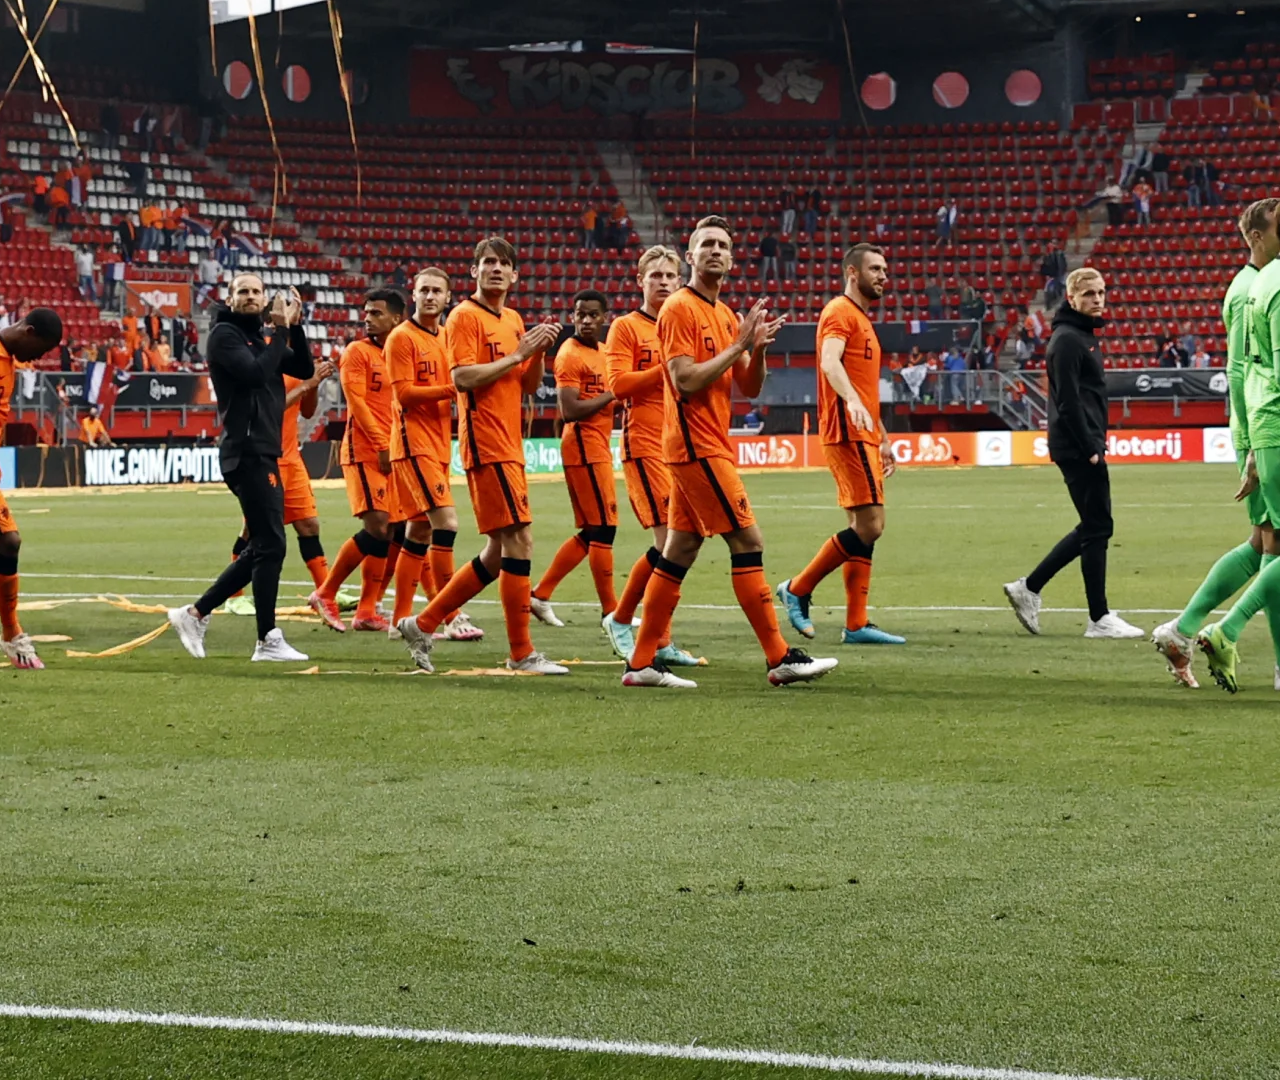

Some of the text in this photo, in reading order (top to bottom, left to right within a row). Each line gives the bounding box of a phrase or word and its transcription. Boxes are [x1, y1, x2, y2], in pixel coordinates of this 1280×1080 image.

[485, 342, 505, 363] 15
[704, 336, 716, 358] 9
[864, 338, 873, 360] 6
[371, 372, 382, 393] 5
[417, 361, 437, 382] 24
[585, 374, 605, 393] 25
[540, 438, 561, 471] kp
[738, 441, 768, 465] ING
[85, 447, 225, 485] NIKE.COM/FOOTB
